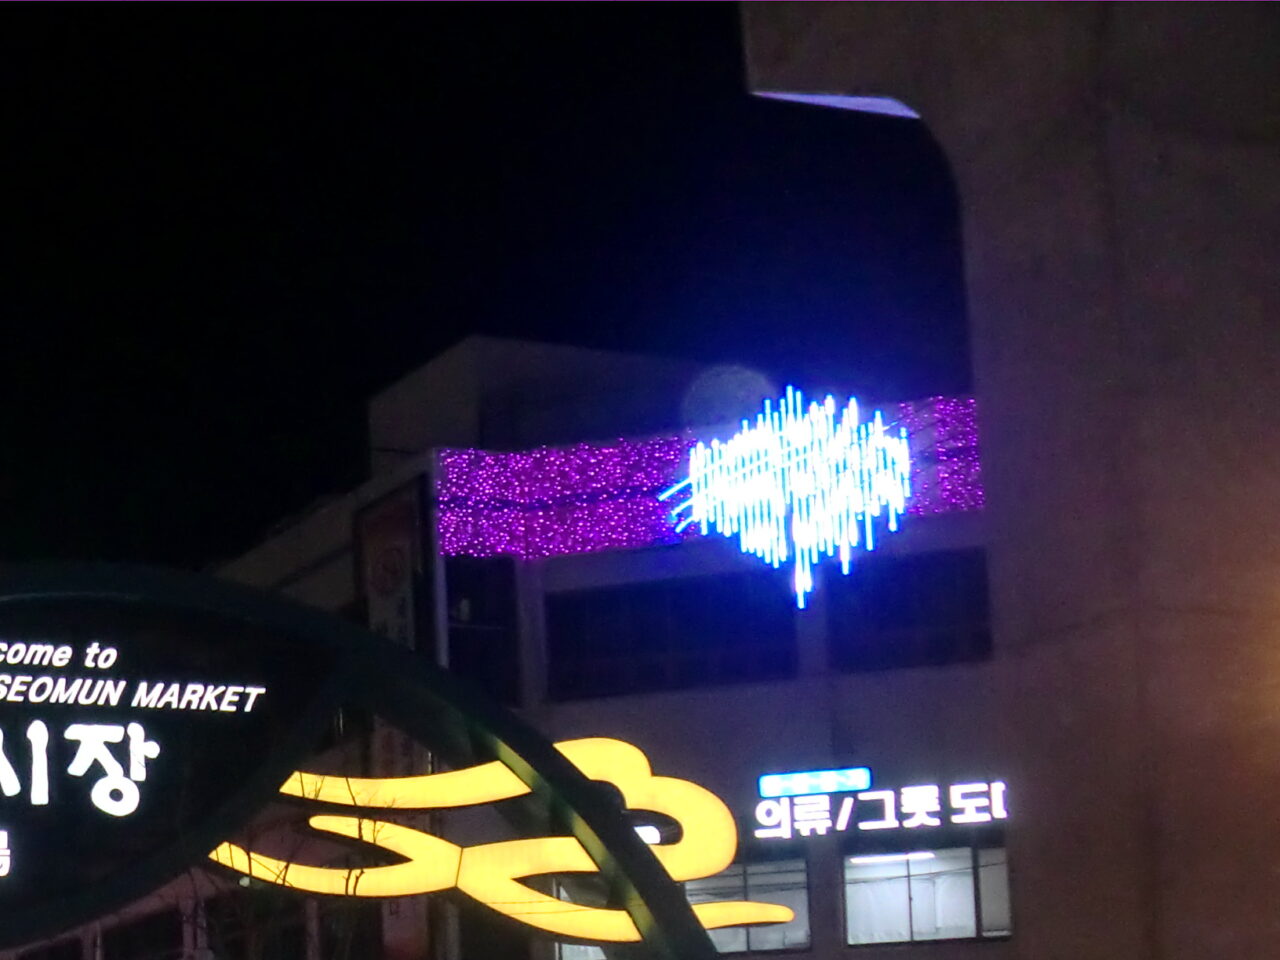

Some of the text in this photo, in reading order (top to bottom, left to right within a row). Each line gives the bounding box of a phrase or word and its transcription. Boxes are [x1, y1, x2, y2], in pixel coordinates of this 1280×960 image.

[84, 641, 118, 669] to
[130, 680, 267, 713] MARKET
[753, 784, 941, 839] 의류/그릇
